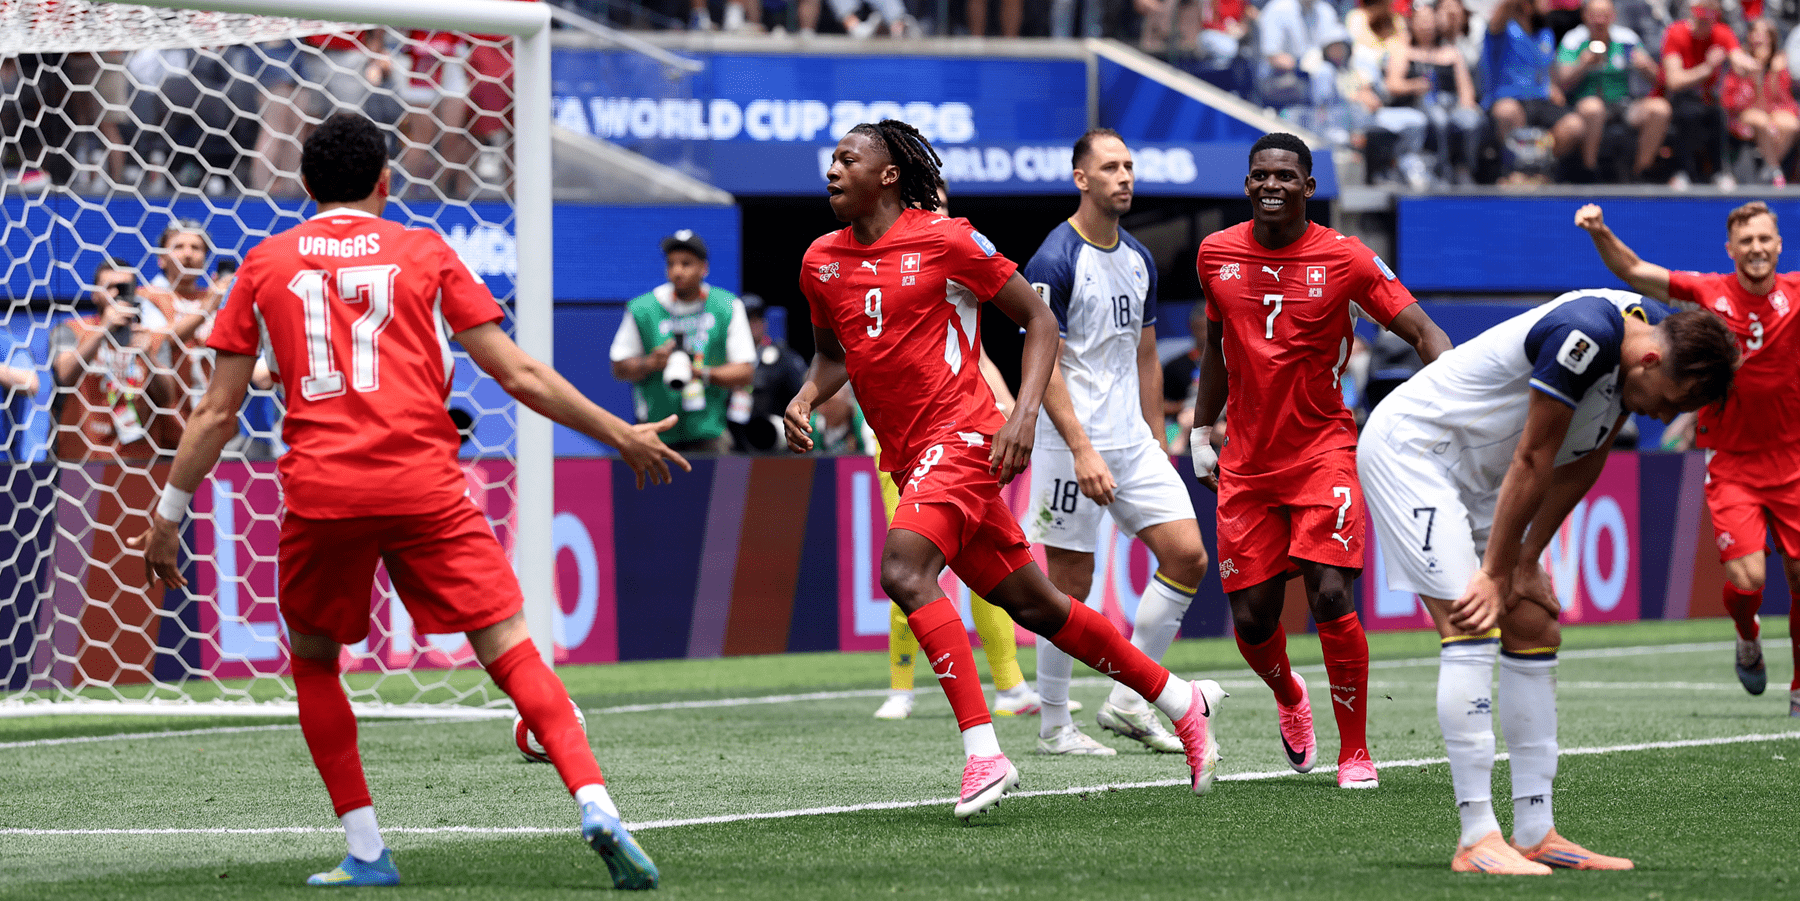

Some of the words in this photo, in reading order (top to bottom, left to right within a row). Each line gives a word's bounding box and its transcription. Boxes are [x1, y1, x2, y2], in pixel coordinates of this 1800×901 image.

[590, 96, 743, 140] WORLD
[744, 99, 830, 141] CUP
[299, 233, 380, 257] VARGAS
[287, 264, 401, 401] 17
[864, 287, 882, 337] 9
[1111, 294, 1130, 328] 18
[1263, 294, 1284, 339] 7
[1746, 321, 1764, 350] 3
[913, 444, 944, 477] 9
[1050, 478, 1079, 514] 18
[1333, 486, 1352, 530] 7
[1413, 507, 1436, 551] 7
